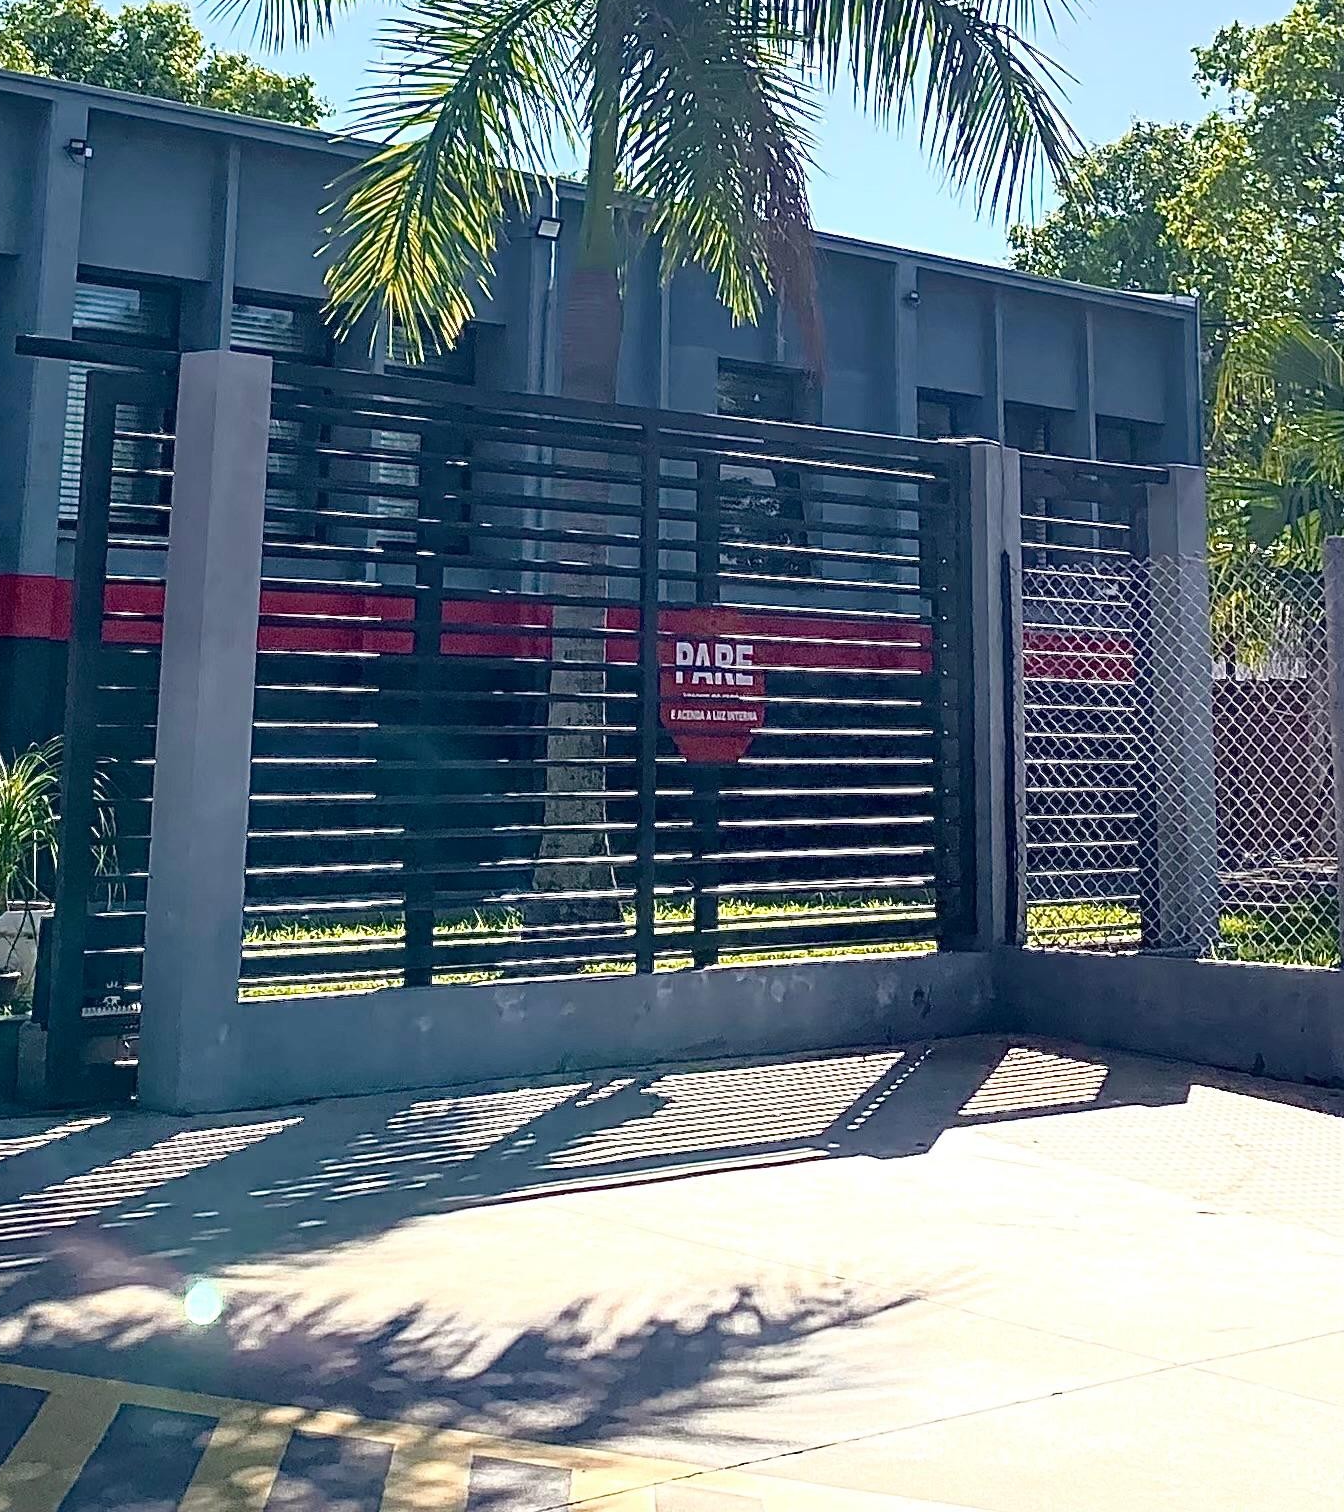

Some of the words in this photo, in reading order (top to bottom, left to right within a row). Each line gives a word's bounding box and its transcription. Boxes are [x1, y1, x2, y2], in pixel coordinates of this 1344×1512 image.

[675, 641, 754, 686] PARE
[670, 709, 676, 720] E
[677, 710, 705, 720] ACENDA
[706, 710, 712, 720] A
[712, 710, 726, 721] LUZ
[727, 710, 758, 721] INTERNA
